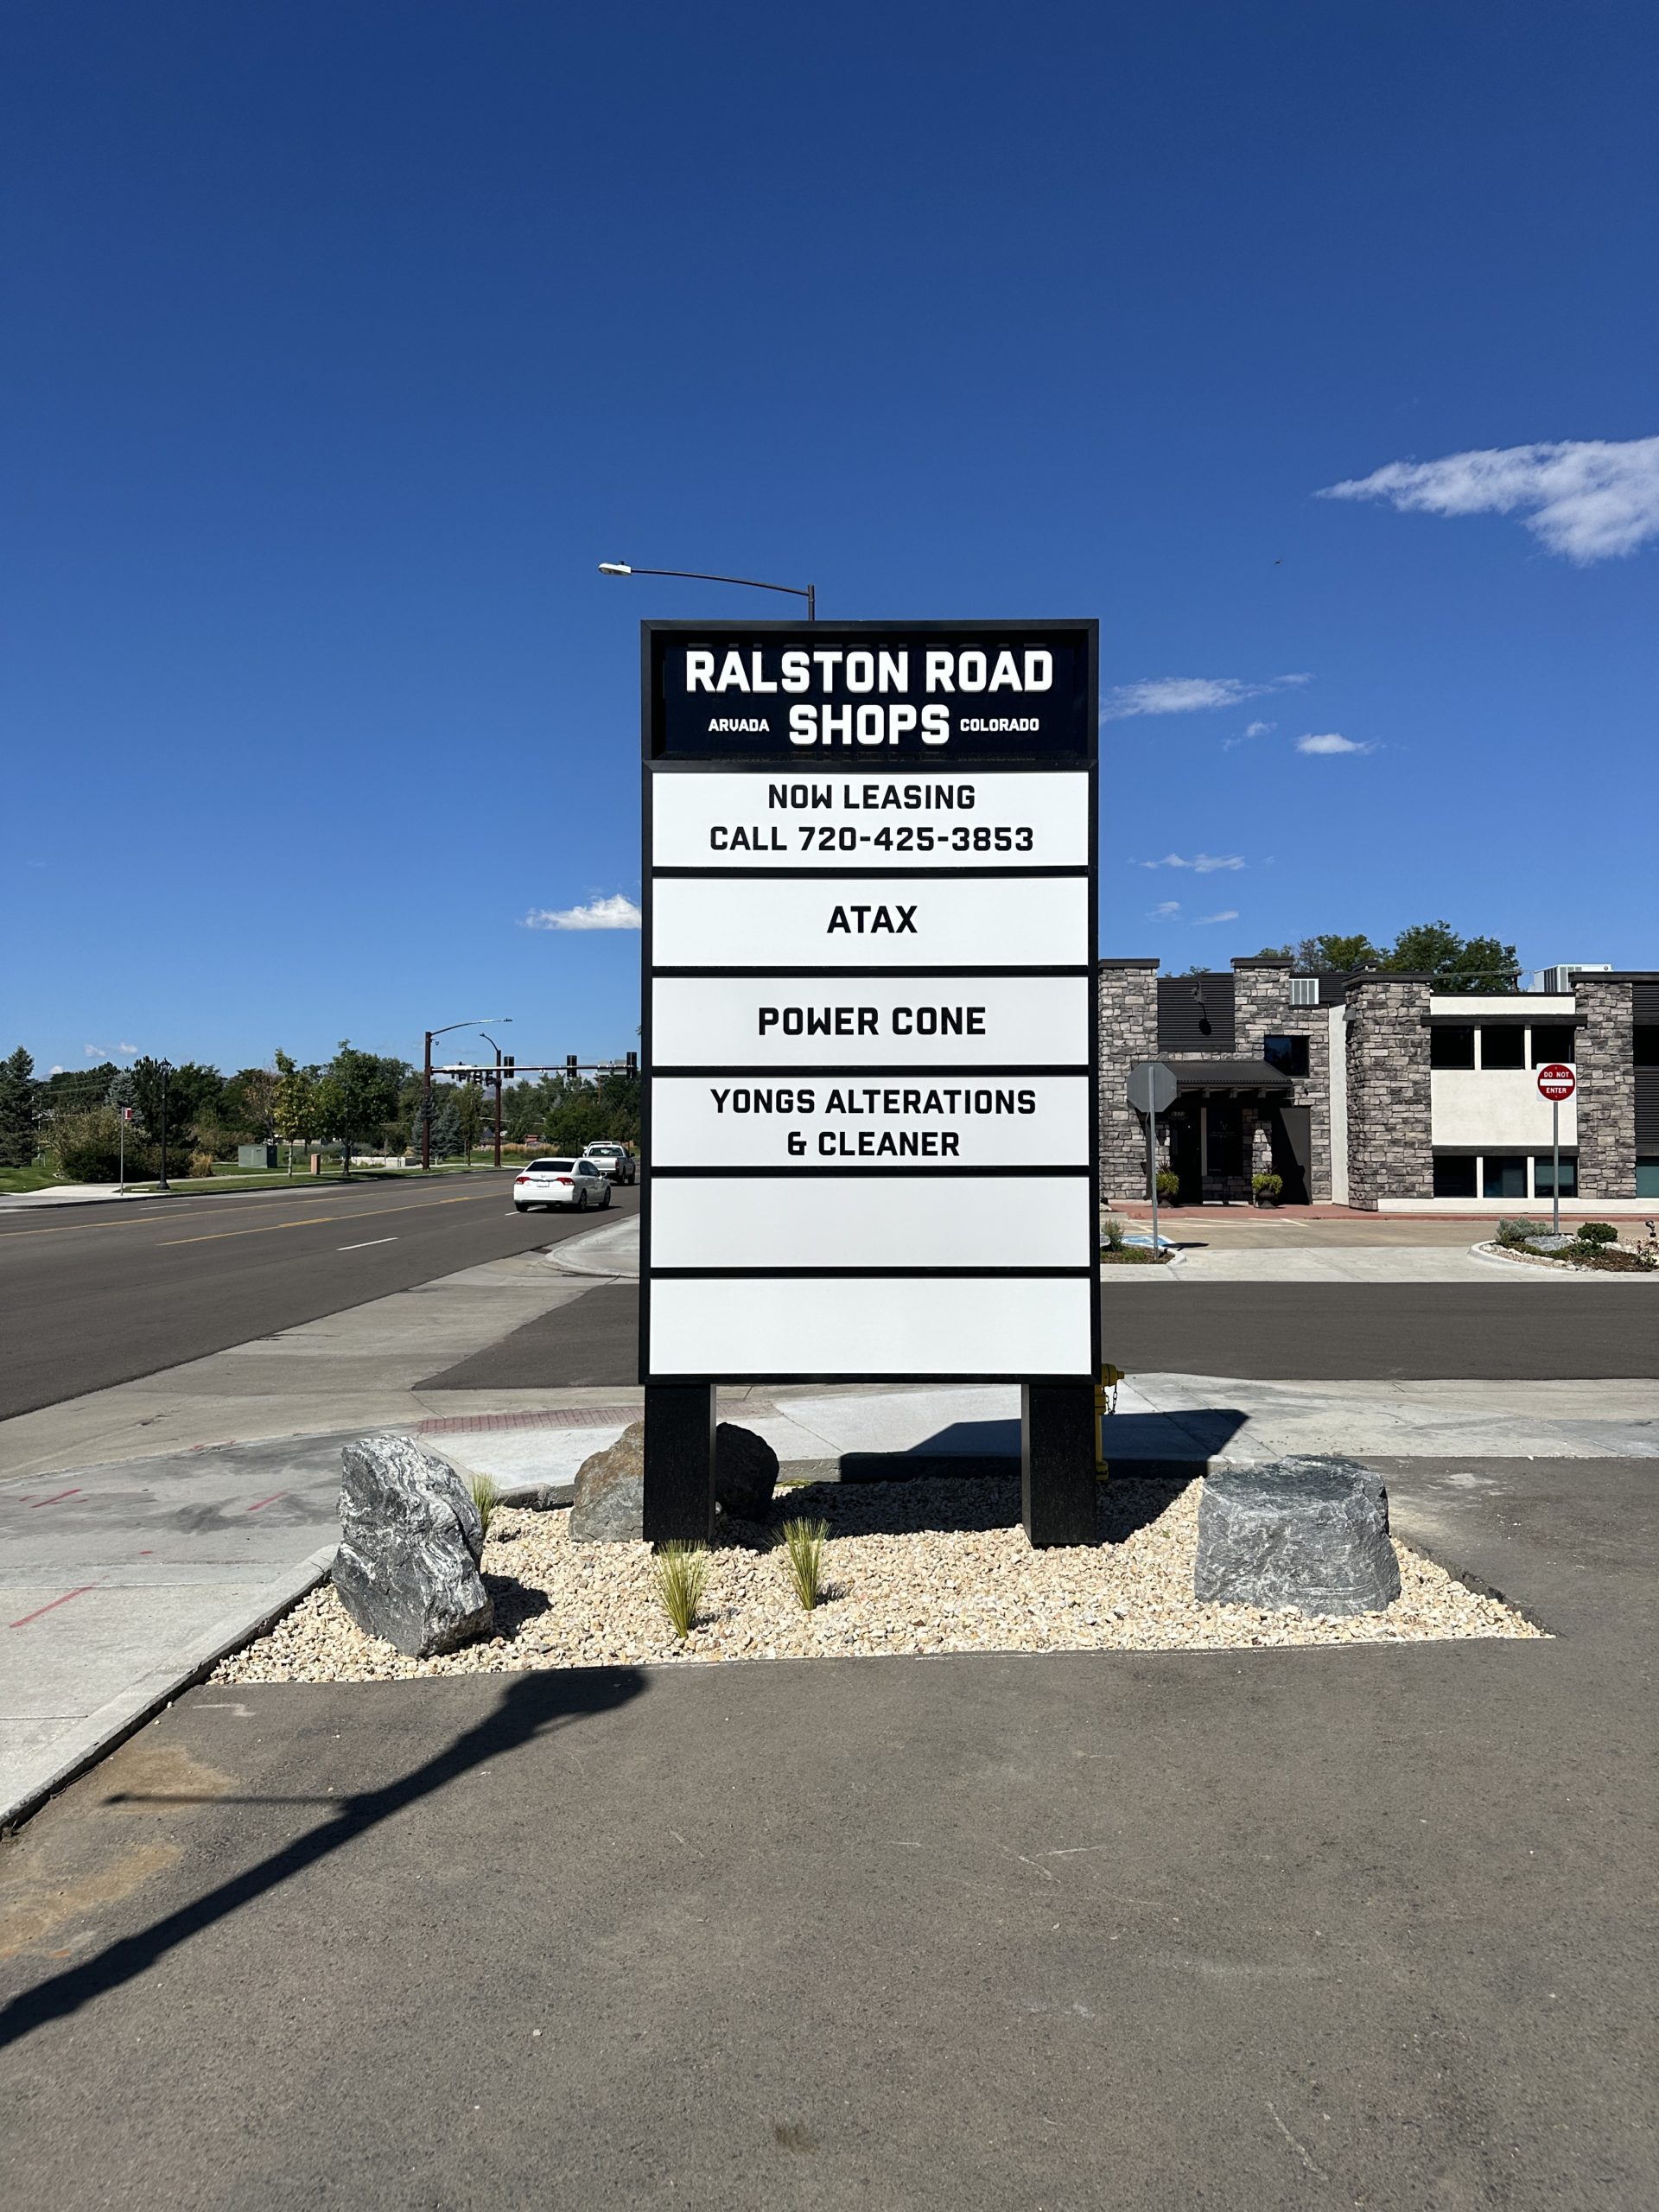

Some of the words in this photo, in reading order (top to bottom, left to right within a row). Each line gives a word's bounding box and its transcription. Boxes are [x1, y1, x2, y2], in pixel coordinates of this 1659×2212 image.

[687, 651, 908, 692] RALSTON
[925, 651, 1053, 692] ROAD
[708, 718, 770, 732] ARVADA
[789, 704, 950, 745] SHOPS
[960, 718, 1039, 732] COLORADO
[768, 784, 832, 809] NOW
[843, 785, 976, 810] LEASING
[710, 826, 788, 851] CALL
[798, 826, 1033, 852] 720-425-3853
[826, 905, 918, 934] ATAX
[759, 1007, 880, 1036] POWER
[892, 1007, 986, 1035] CONE
[709, 1089, 815, 1114] YONGS
[824, 1089, 1036, 1115] ALTERATIONS
[787, 1131, 807, 1156] &
[818, 1131, 960, 1157] CLEANER
